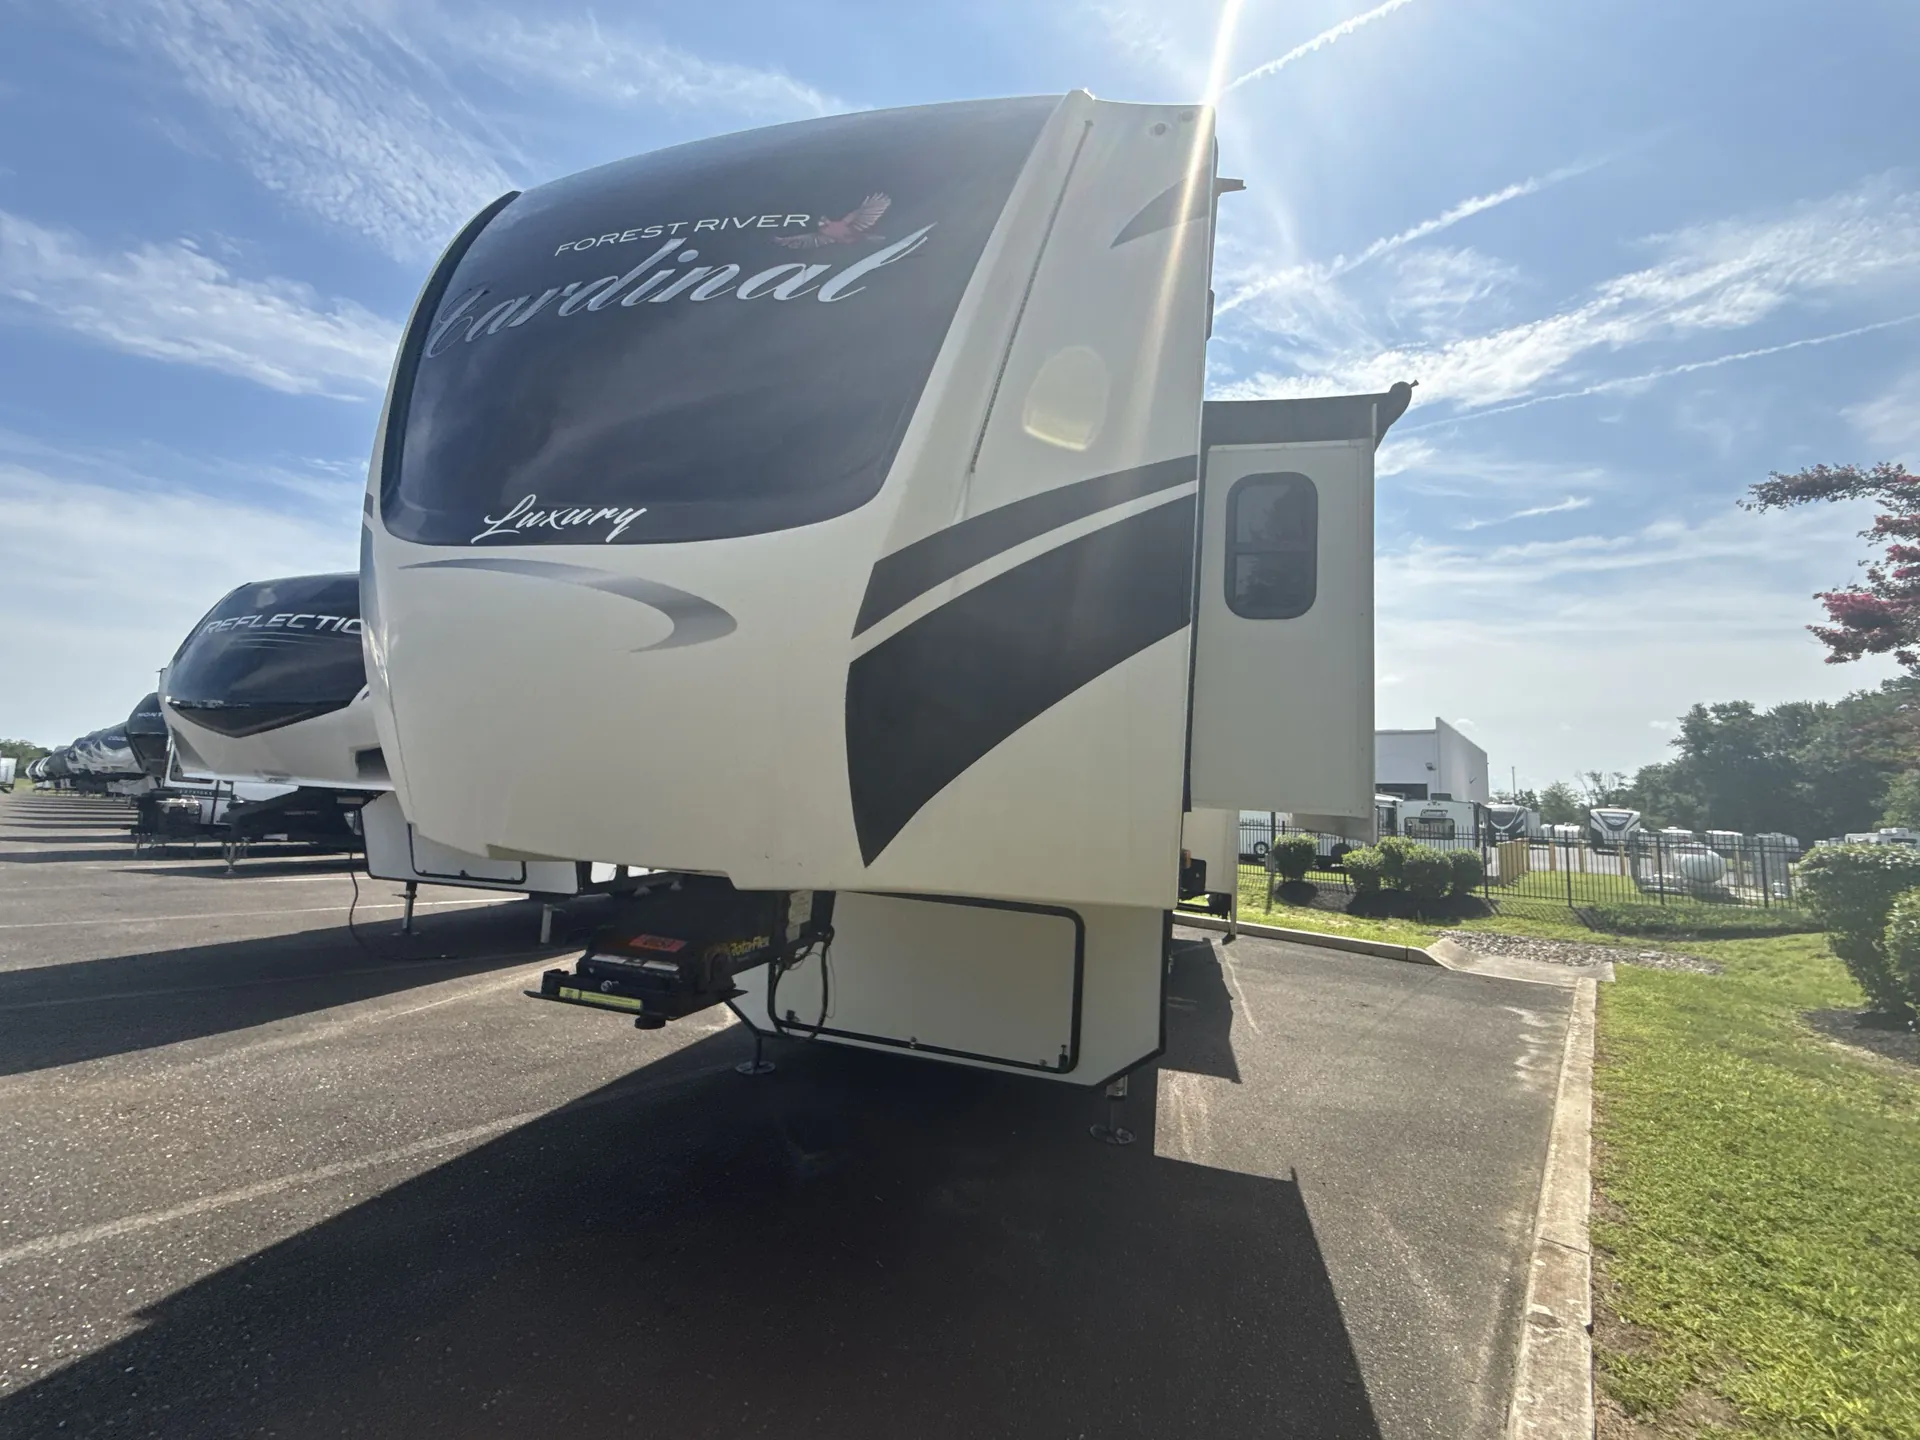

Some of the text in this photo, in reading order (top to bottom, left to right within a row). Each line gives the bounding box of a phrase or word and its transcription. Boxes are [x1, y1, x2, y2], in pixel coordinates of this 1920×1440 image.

[554, 213, 811, 257] FOREST RIVER
[425, 221, 939, 359] Cardinal
[470, 493, 648, 544] Luxury
[199, 612, 363, 637] REFLECTIO
